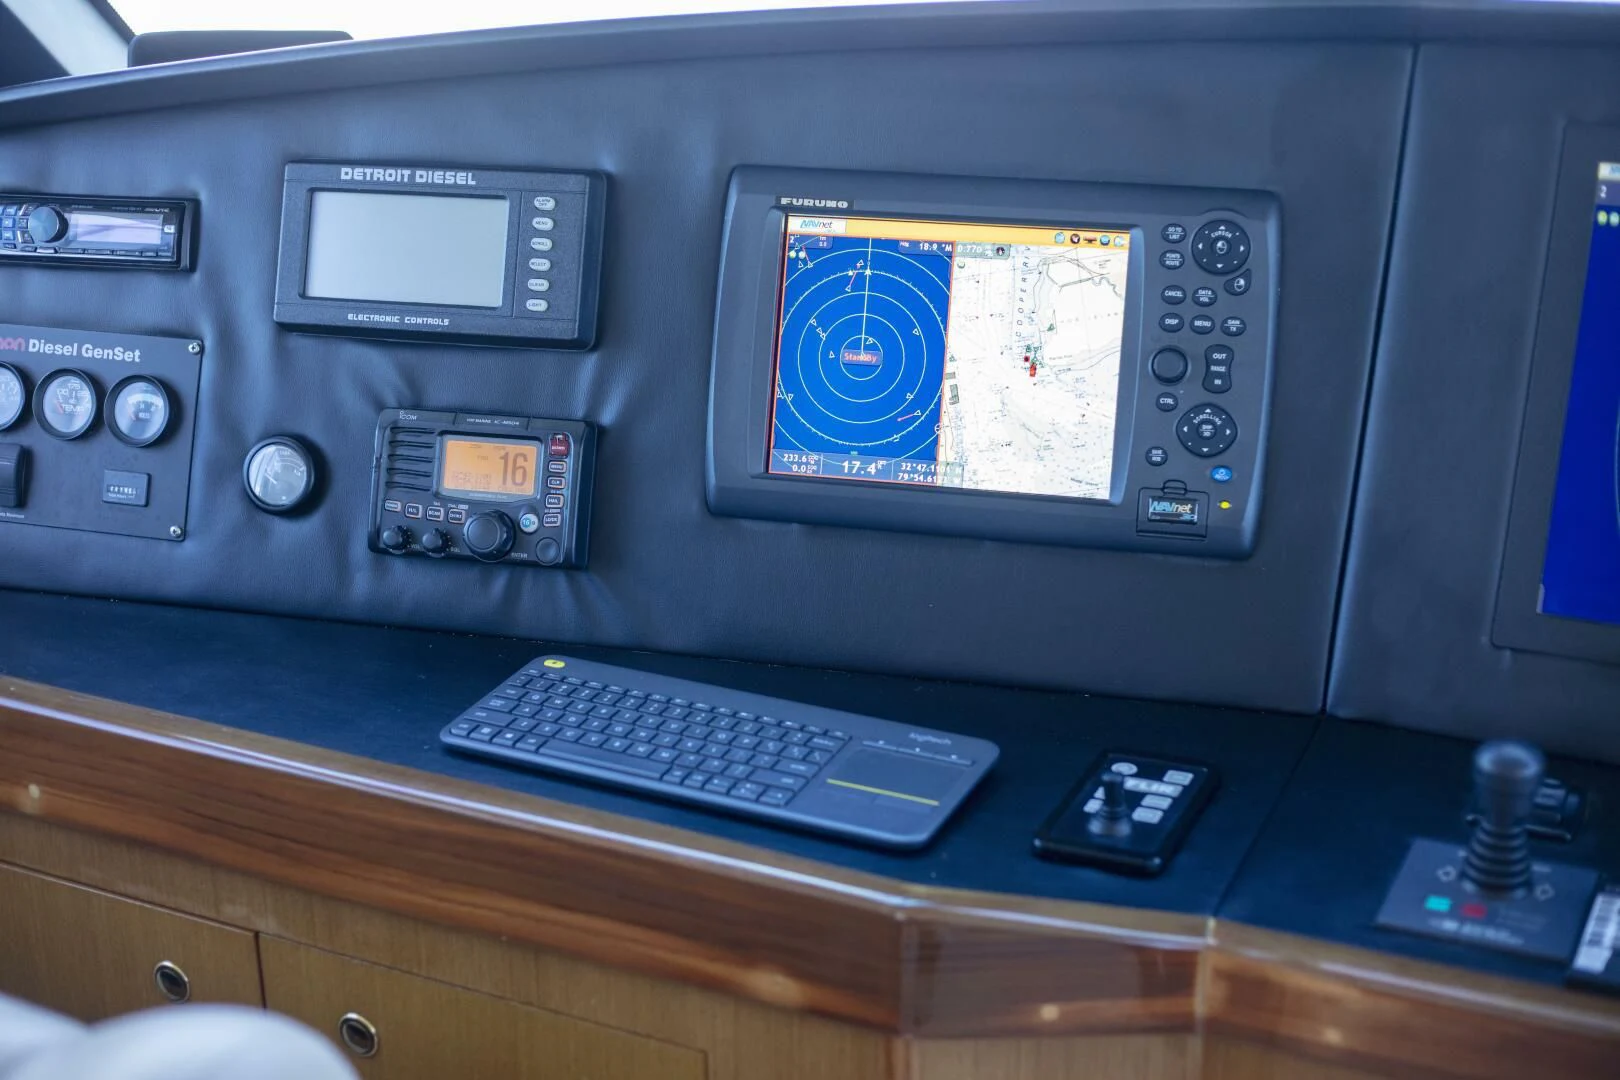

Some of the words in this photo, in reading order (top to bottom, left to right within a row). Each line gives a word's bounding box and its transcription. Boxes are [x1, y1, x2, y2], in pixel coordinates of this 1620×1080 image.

[340, 167, 411, 183] DETROIT
[415, 170, 477, 185] DIESEL
[780, 197, 849, 209] FURUNO
[1210, 230, 1233, 238] CURSOR
[919, 242, 938, 251] 18.9
[347, 313, 401, 323] ELECTRONIC
[404, 316, 450, 326] CONTROLS
[1194, 319, 1212, 327] MENU
[28, 339, 78, 356] Diesel
[81, 343, 141, 363] GenSet
[1159, 397, 1175, 405] CTRL
[783, 453, 807, 463] 233.6
[498, 451, 529, 487] 16
[792, 464, 807, 473] 0.0
[842, 460, 876, 476] 17.4
[1150, 500, 1193, 514] NAVnet
